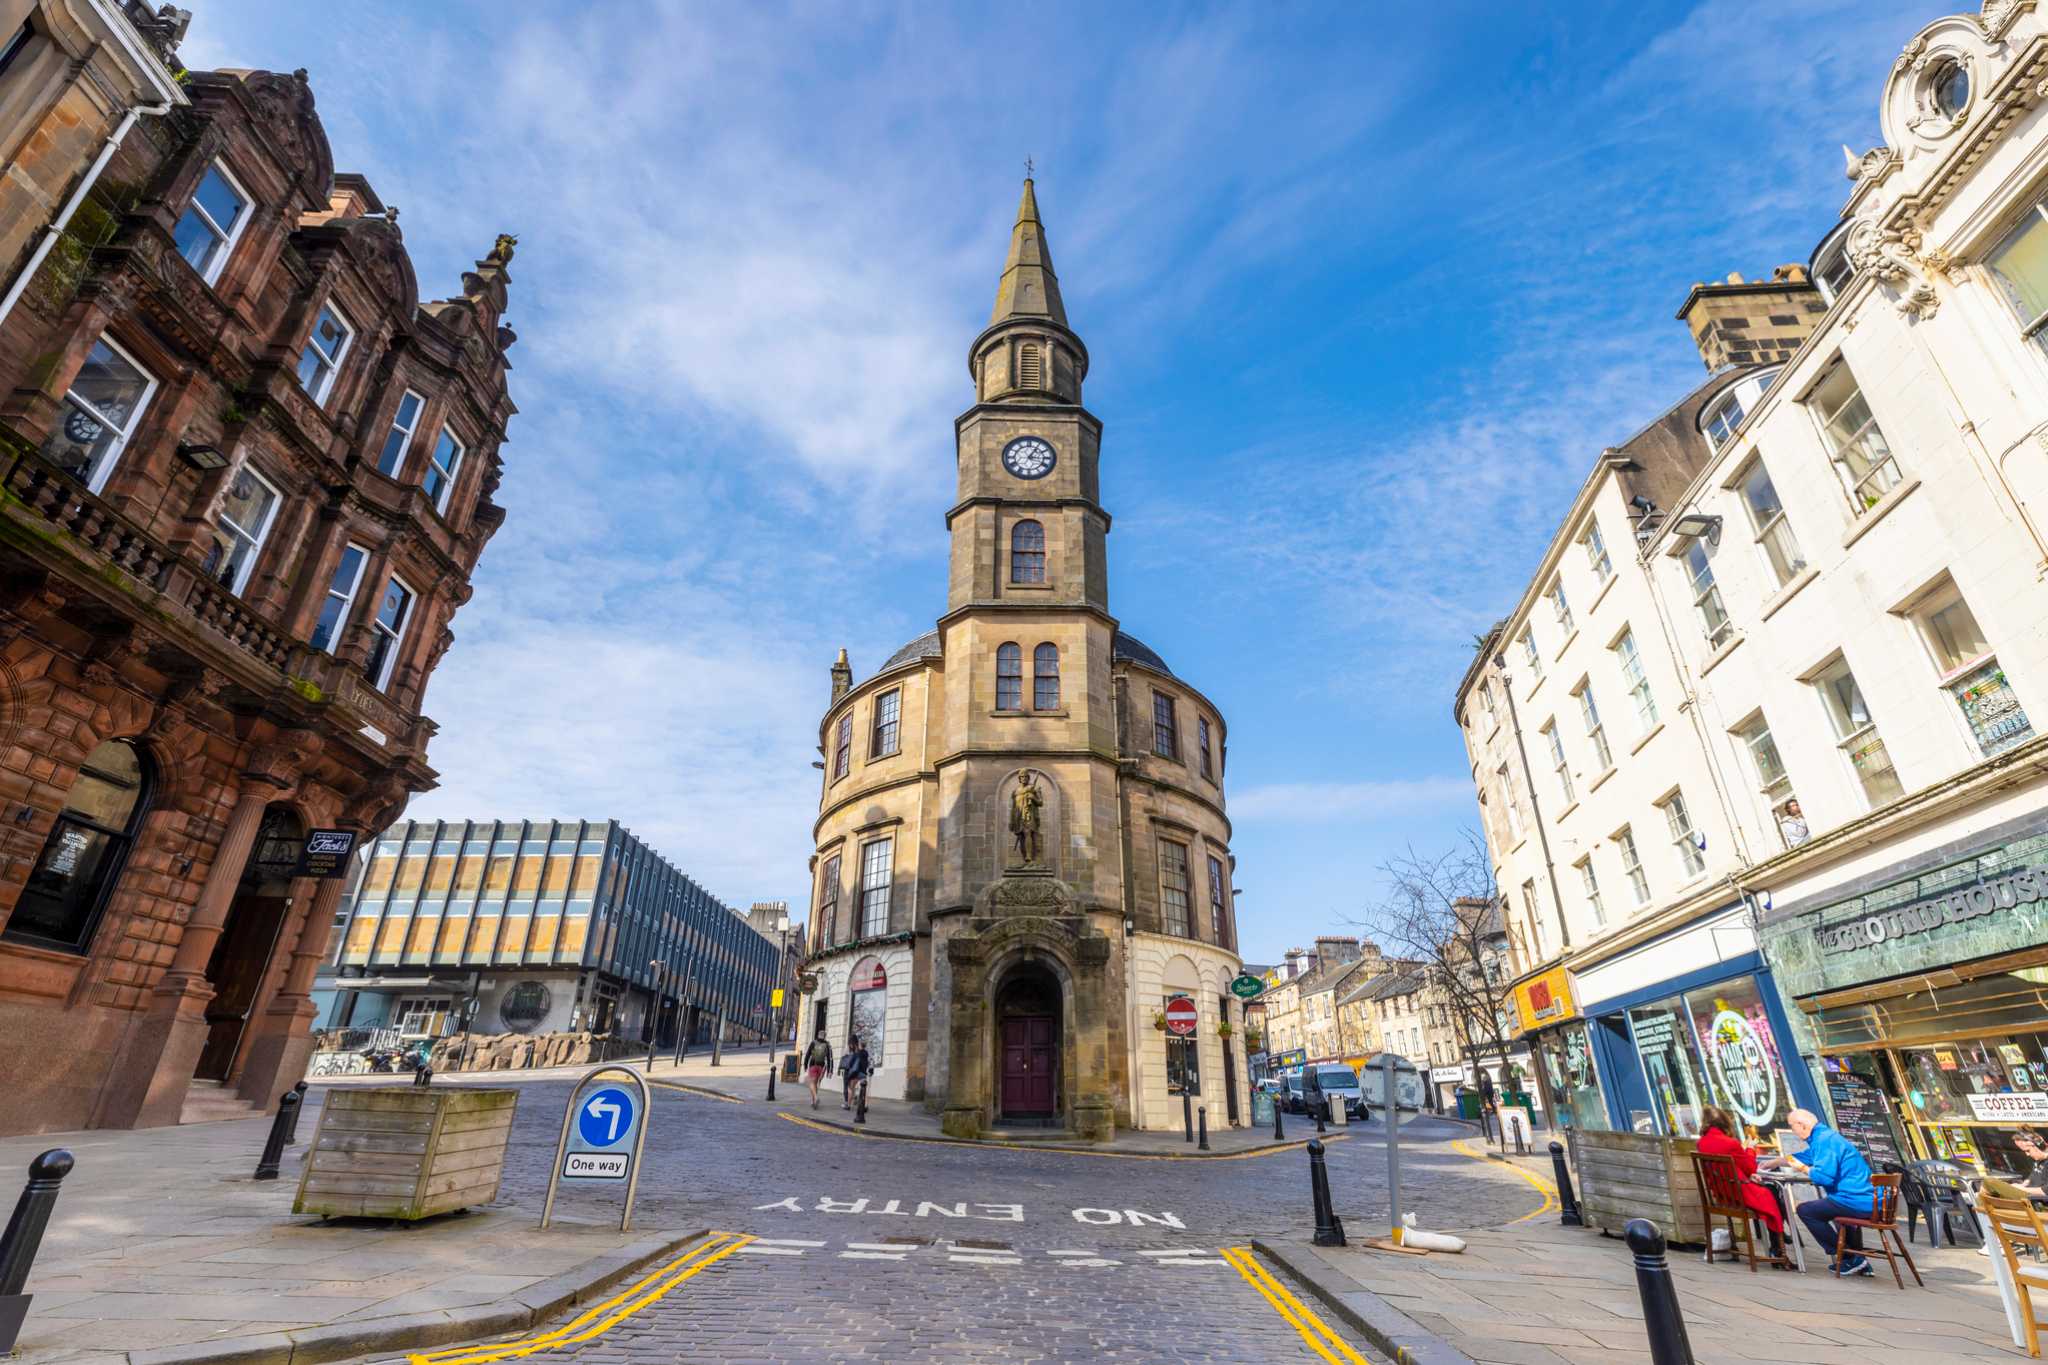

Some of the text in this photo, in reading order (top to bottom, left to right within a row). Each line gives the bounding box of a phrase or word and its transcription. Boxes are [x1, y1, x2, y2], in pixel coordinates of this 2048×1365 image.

[1984, 1097, 2034, 1111] COFFEE
[571, 1158, 622, 1173] One way
[752, 1196, 1187, 1229] NO ENTRY
